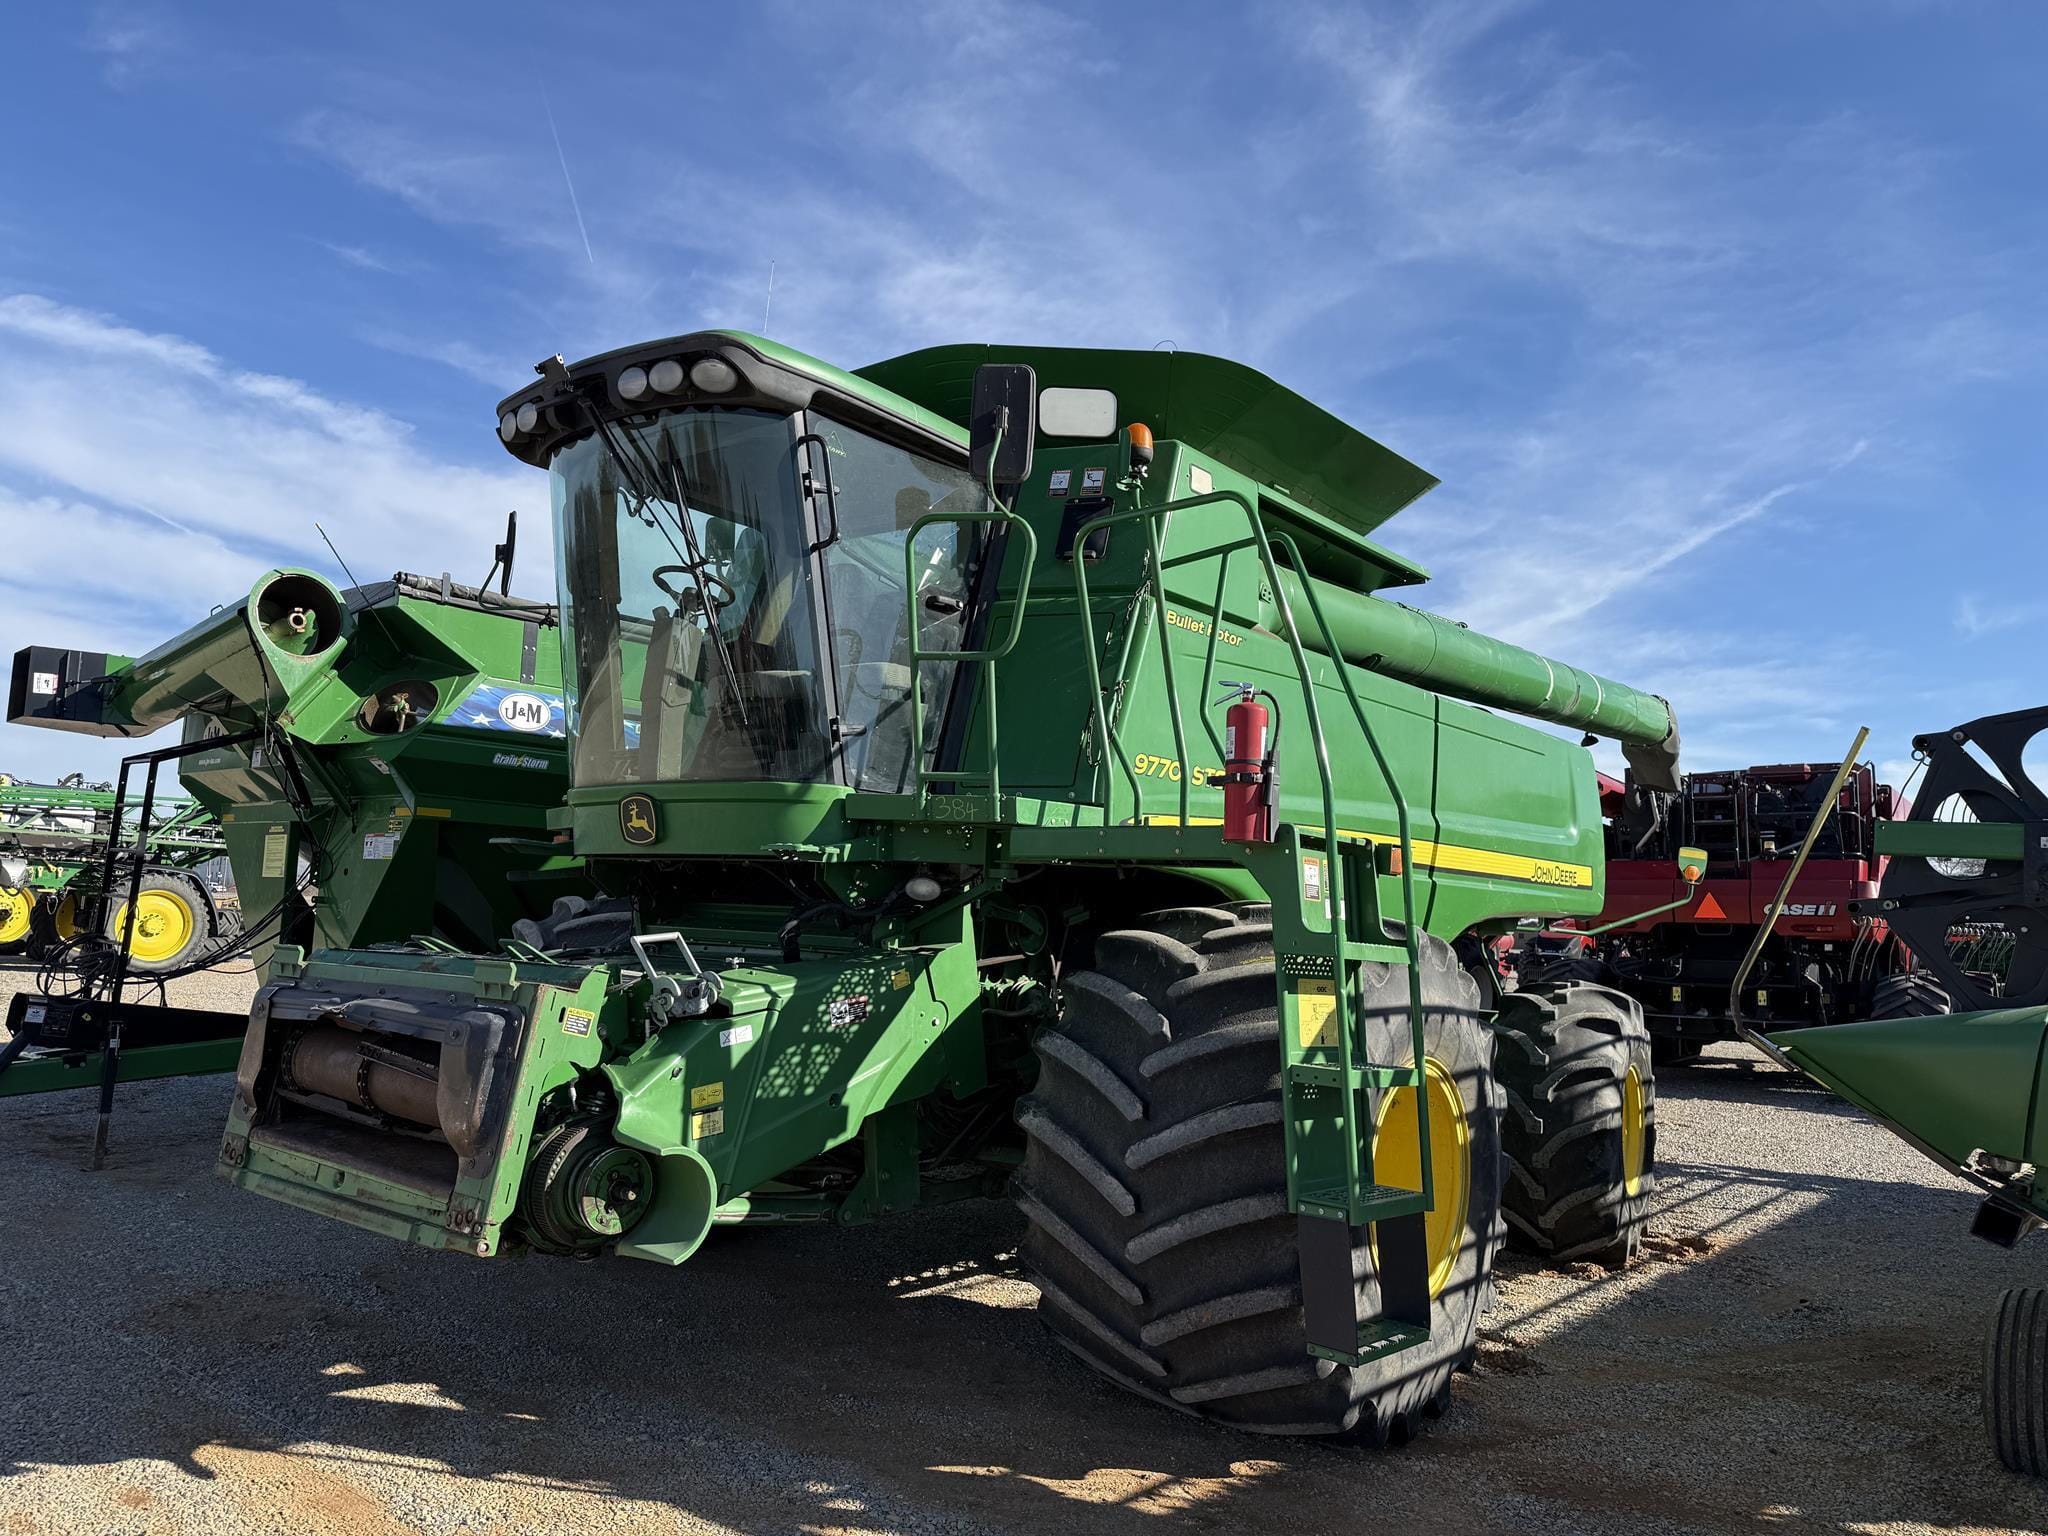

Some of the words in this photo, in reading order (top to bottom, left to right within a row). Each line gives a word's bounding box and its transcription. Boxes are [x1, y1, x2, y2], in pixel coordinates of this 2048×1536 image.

[1167, 609, 1205, 634] Bullet
[1207, 623, 1243, 646] otor
[505, 701, 542, 723] J&M
[1134, 753, 1181, 782] 9770
[935, 796, 979, 820] 384
[1531, 863, 1554, 881] JOHN
[1555, 866, 1577, 884] DEERE
